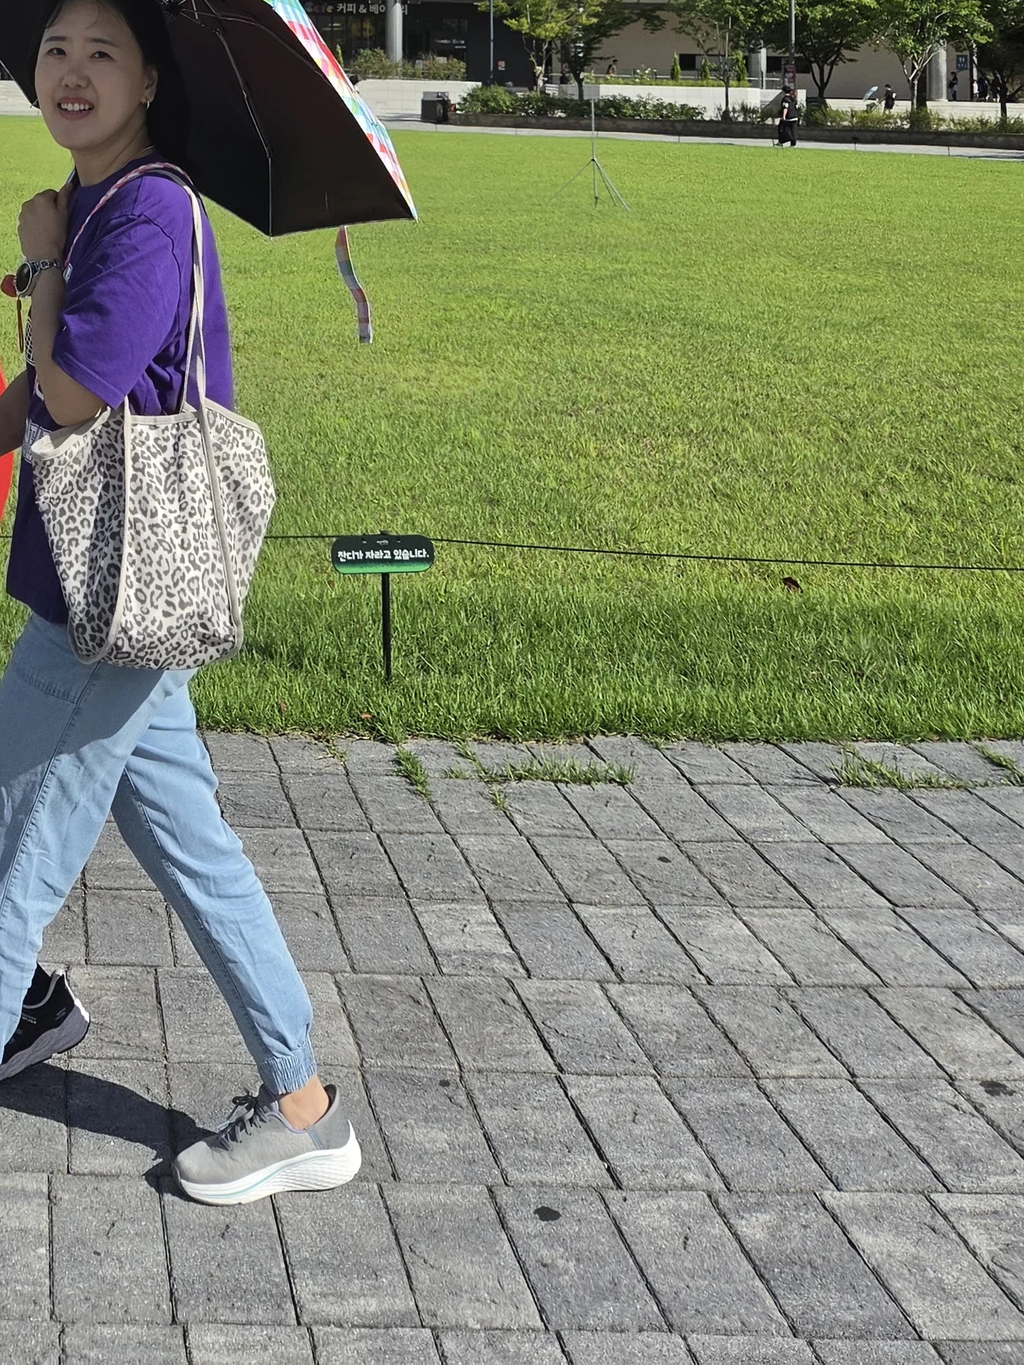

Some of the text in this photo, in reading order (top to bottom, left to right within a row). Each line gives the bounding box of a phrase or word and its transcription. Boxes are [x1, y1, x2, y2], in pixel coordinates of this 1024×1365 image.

[337, 3, 409, 16] 커피 & 베이리
[337, 548, 430, 562] 잔디가 자라고 있습니다.
